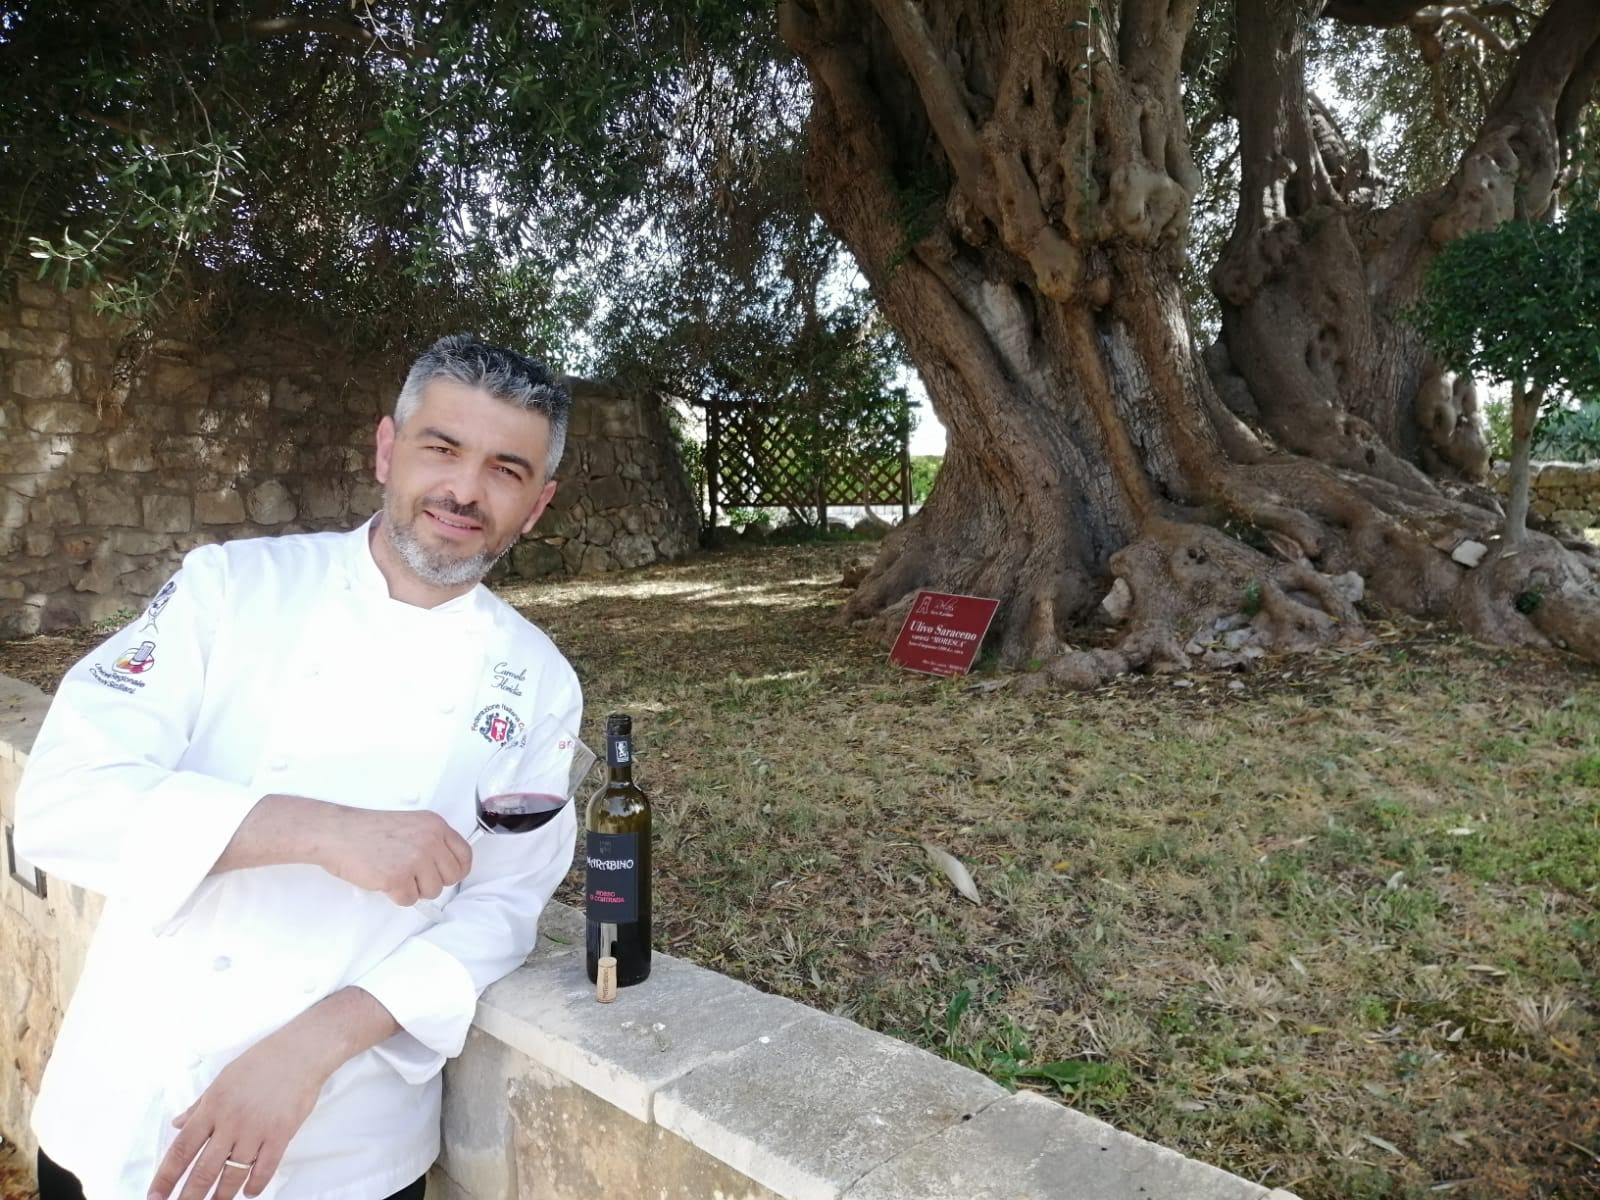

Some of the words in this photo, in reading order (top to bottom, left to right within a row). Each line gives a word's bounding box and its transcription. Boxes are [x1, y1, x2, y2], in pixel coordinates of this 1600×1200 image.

[910, 620, 934, 633] Ulivo
[934, 625, 977, 641] Saraceno
[493, 662, 527, 681] Carmelo
[471, 704, 500, 731] Federazione
